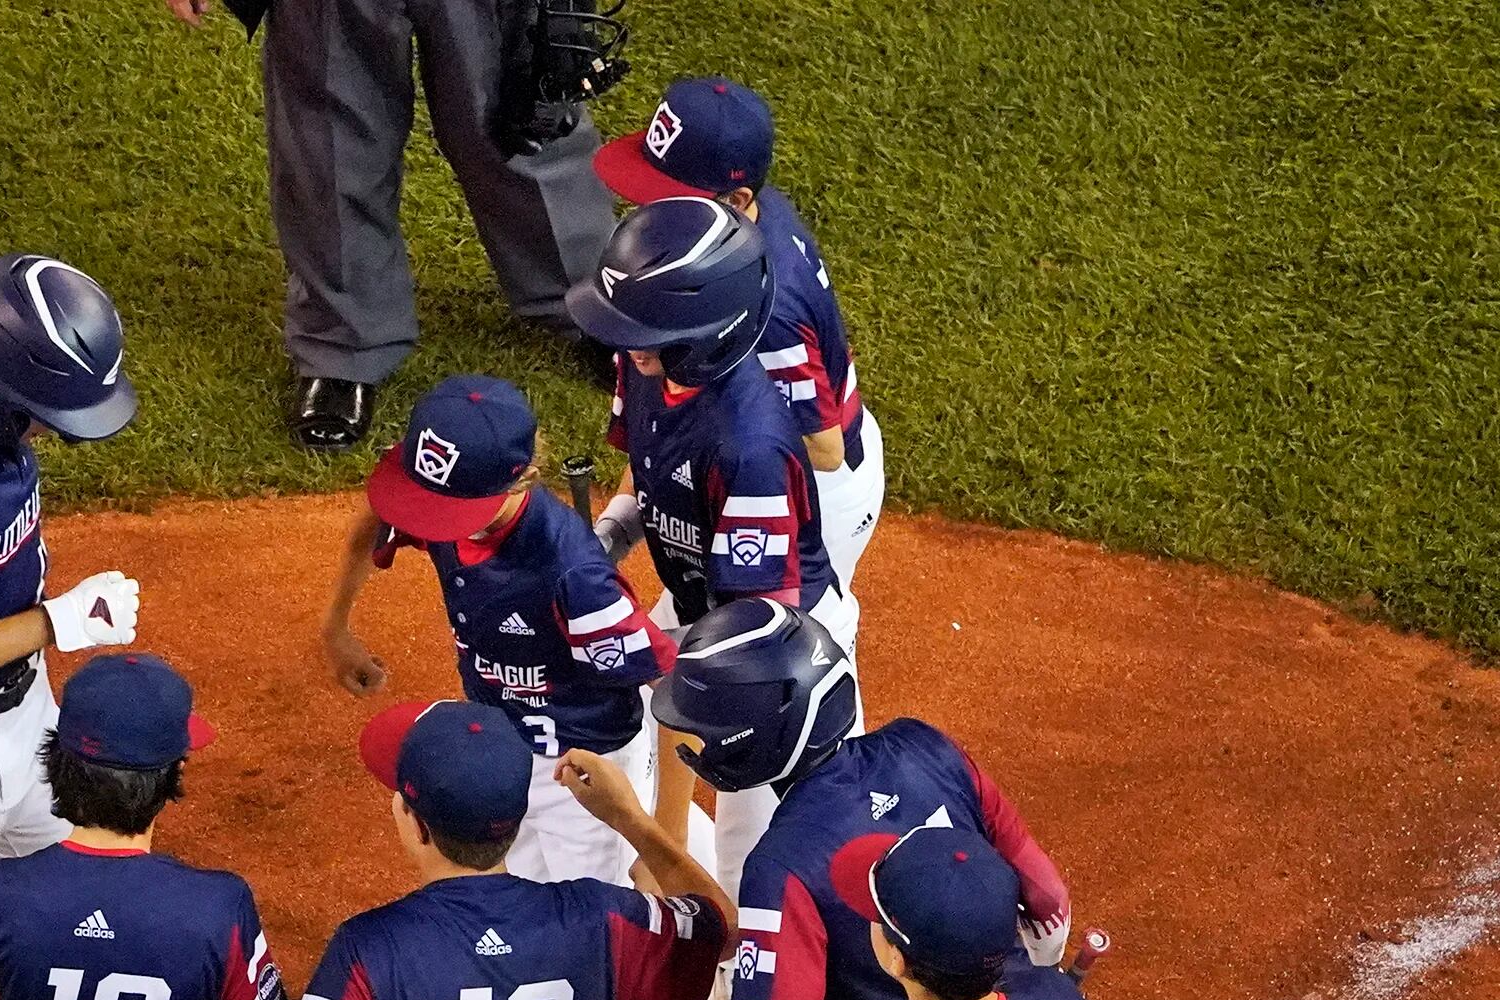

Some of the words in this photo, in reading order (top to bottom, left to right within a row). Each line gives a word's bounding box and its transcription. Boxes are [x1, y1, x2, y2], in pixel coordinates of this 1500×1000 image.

[718, 309, 748, 339] EASTON
[499, 625, 536, 636] adidas
[721, 727, 754, 746] EASTON
[872, 794, 900, 820] adidas
[73, 926, 115, 939] adidas
[475, 944, 513, 956] adidas
